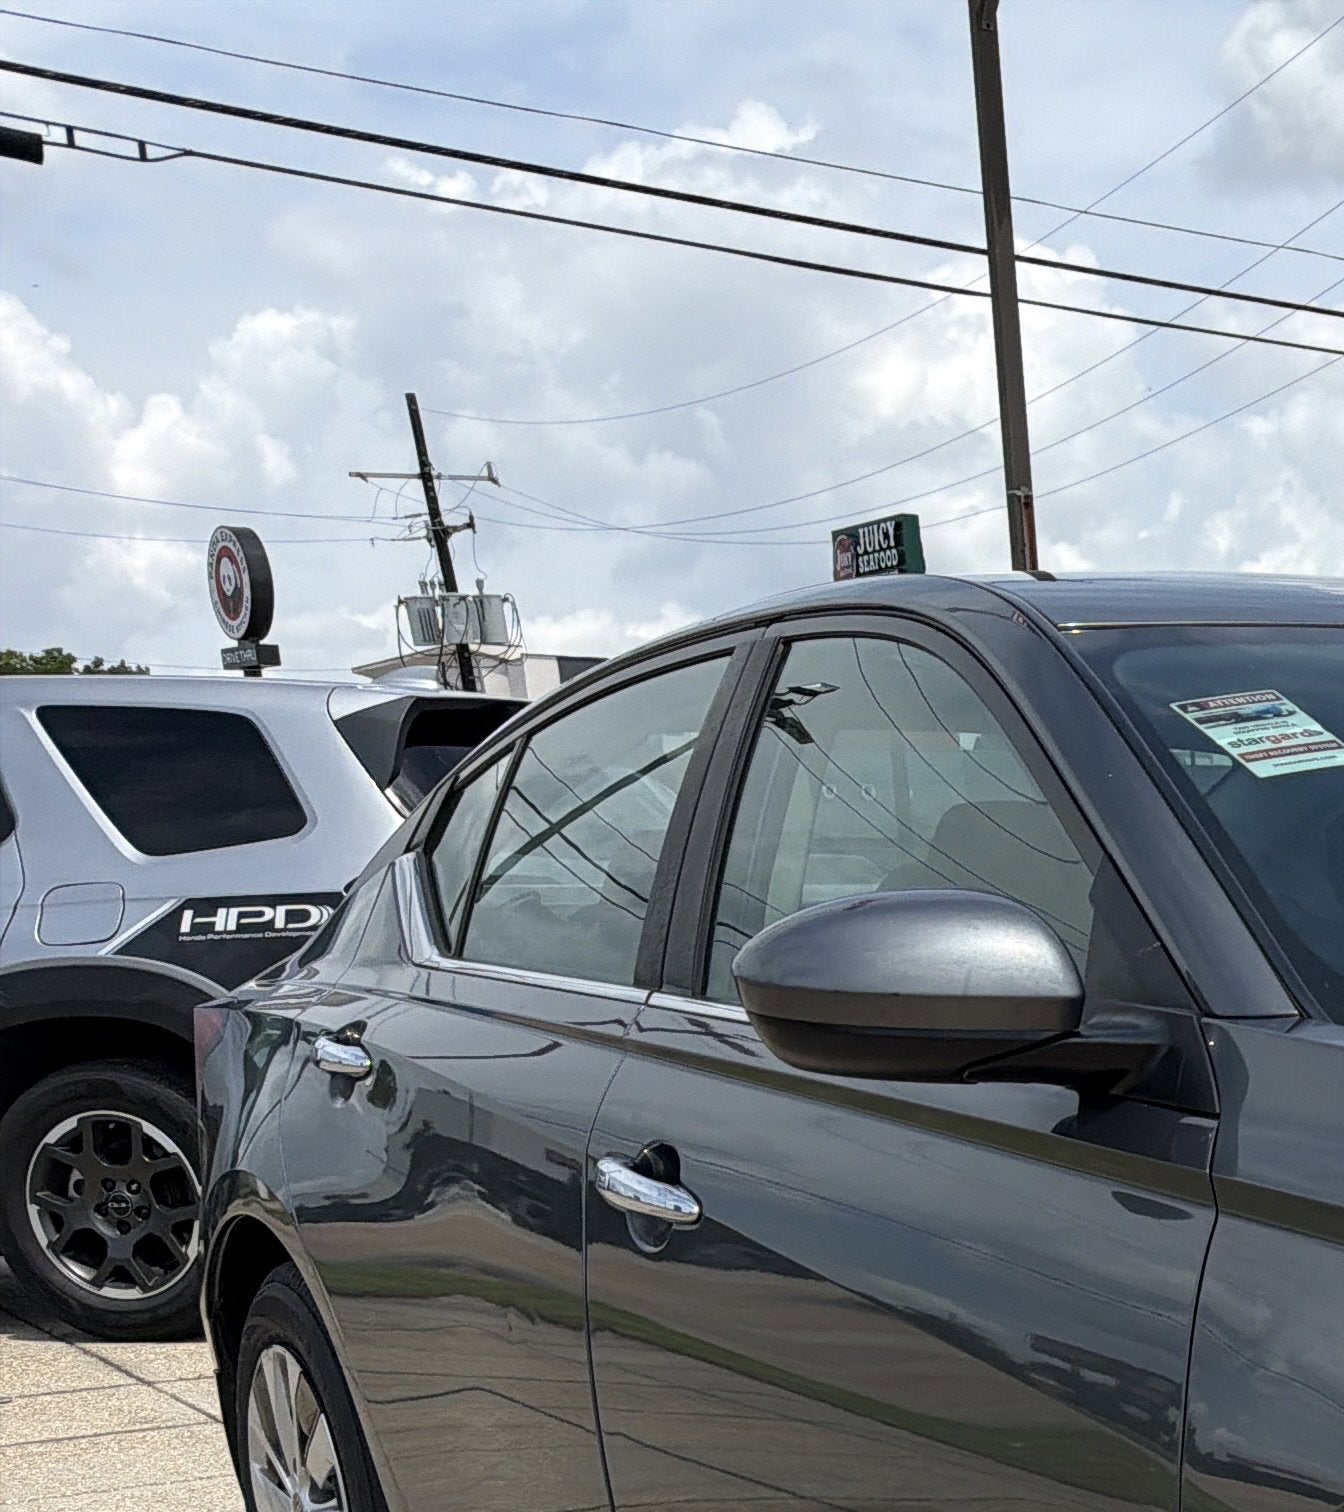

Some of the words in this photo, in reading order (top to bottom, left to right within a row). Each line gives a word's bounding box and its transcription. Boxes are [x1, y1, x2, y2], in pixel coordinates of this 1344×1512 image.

[857, 520, 896, 554] JUICY
[858, 549, 899, 573] SEAFOOD
[1208, 693, 1277, 708] ATTENTION
[179, 904, 323, 934] HPD
[179, 934, 206, 942] Honda
[207, 932, 263, 940] Performance
